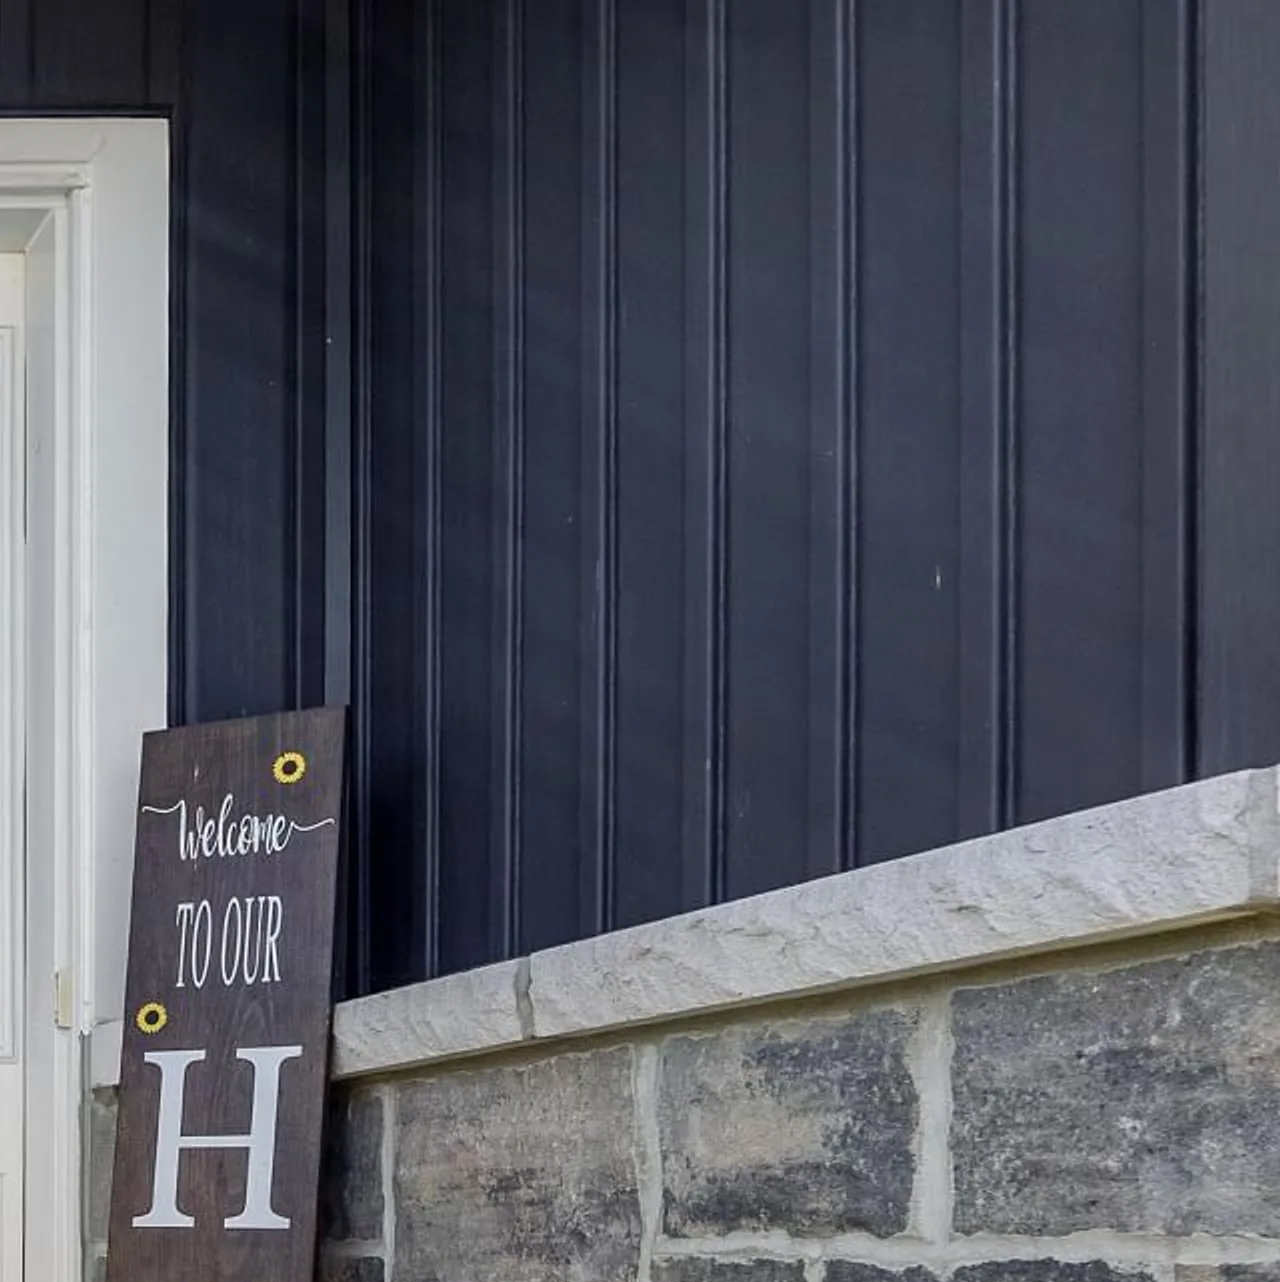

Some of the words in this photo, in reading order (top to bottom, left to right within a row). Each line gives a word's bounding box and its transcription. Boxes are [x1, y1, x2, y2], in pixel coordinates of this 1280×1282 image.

[142, 793, 335, 861] Welcome
[176, 900, 212, 988] TO
[221, 895, 284, 986] OUR
